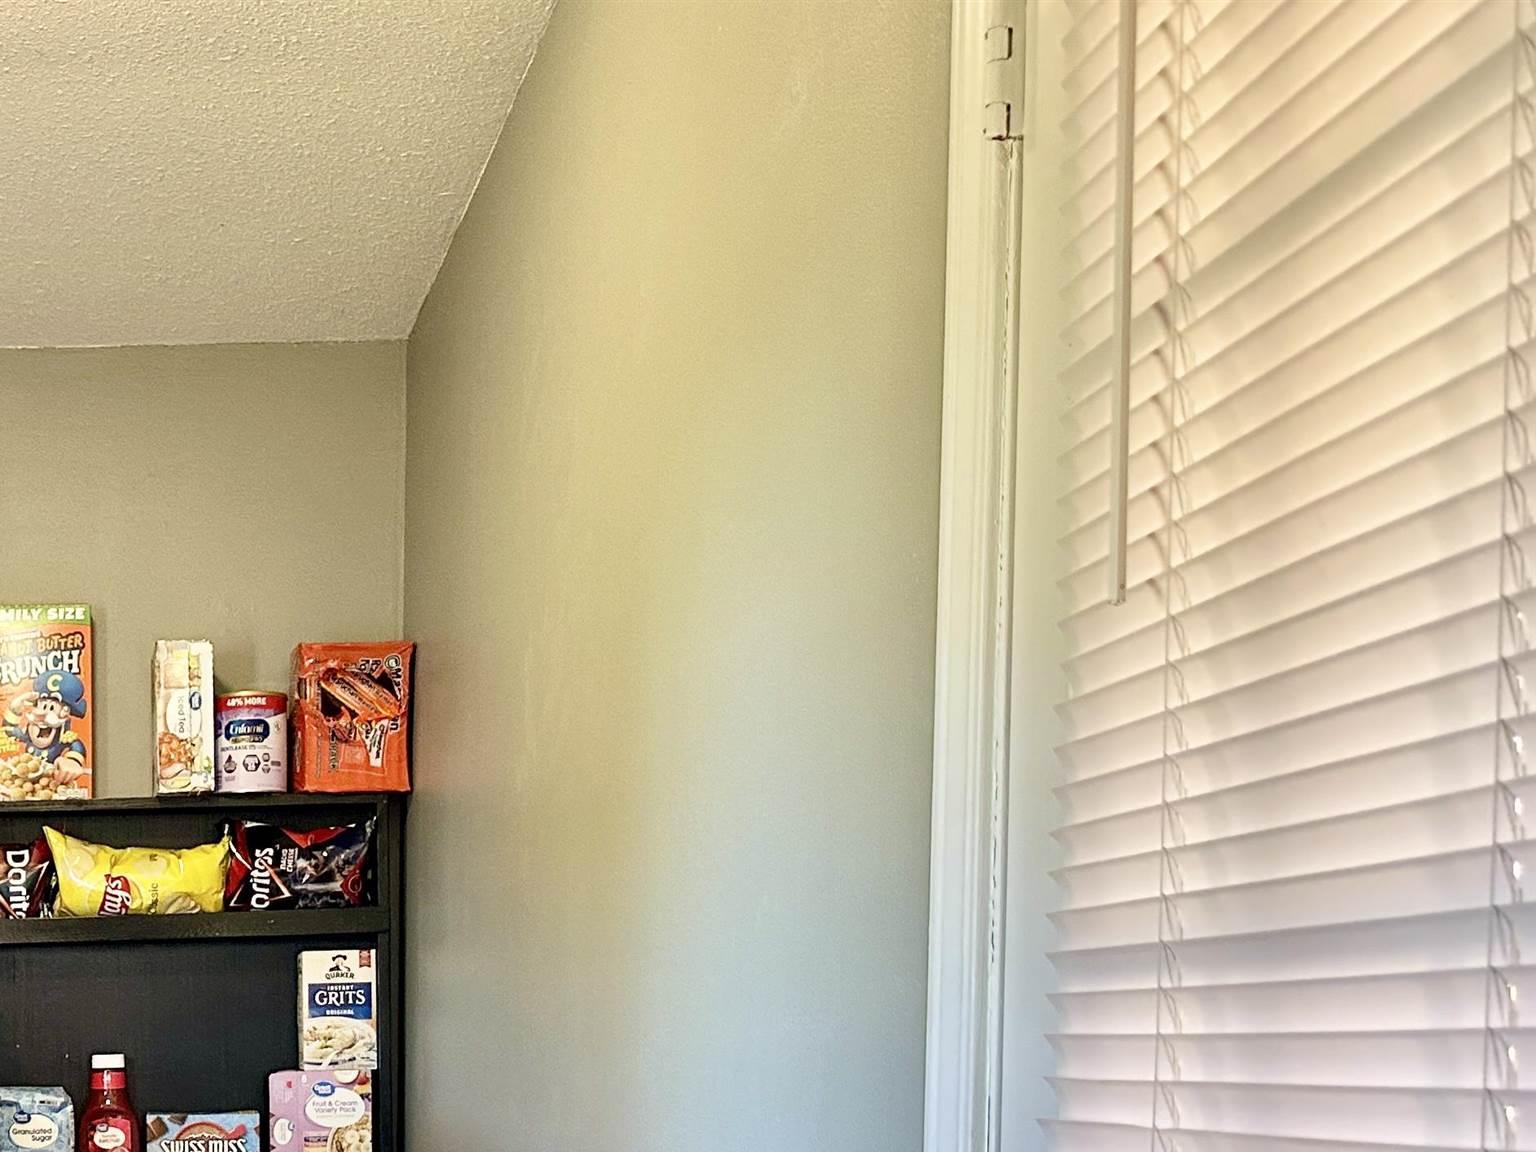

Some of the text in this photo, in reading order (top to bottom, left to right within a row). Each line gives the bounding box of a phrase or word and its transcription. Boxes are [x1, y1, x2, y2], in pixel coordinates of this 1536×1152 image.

[46, 607, 86, 620] SIZE
[37, 633, 83, 653] BUTTER
[286, 848, 295, 873] CHEESE
[5, 849, 30, 919] Dorit
[249, 846, 275, 912] oritos
[104, 876, 133, 915] ay's
[325, 971, 355, 980] QUAKER
[314, 989, 366, 1006] GRITS
[31, 1134, 53, 1142] Sugar
